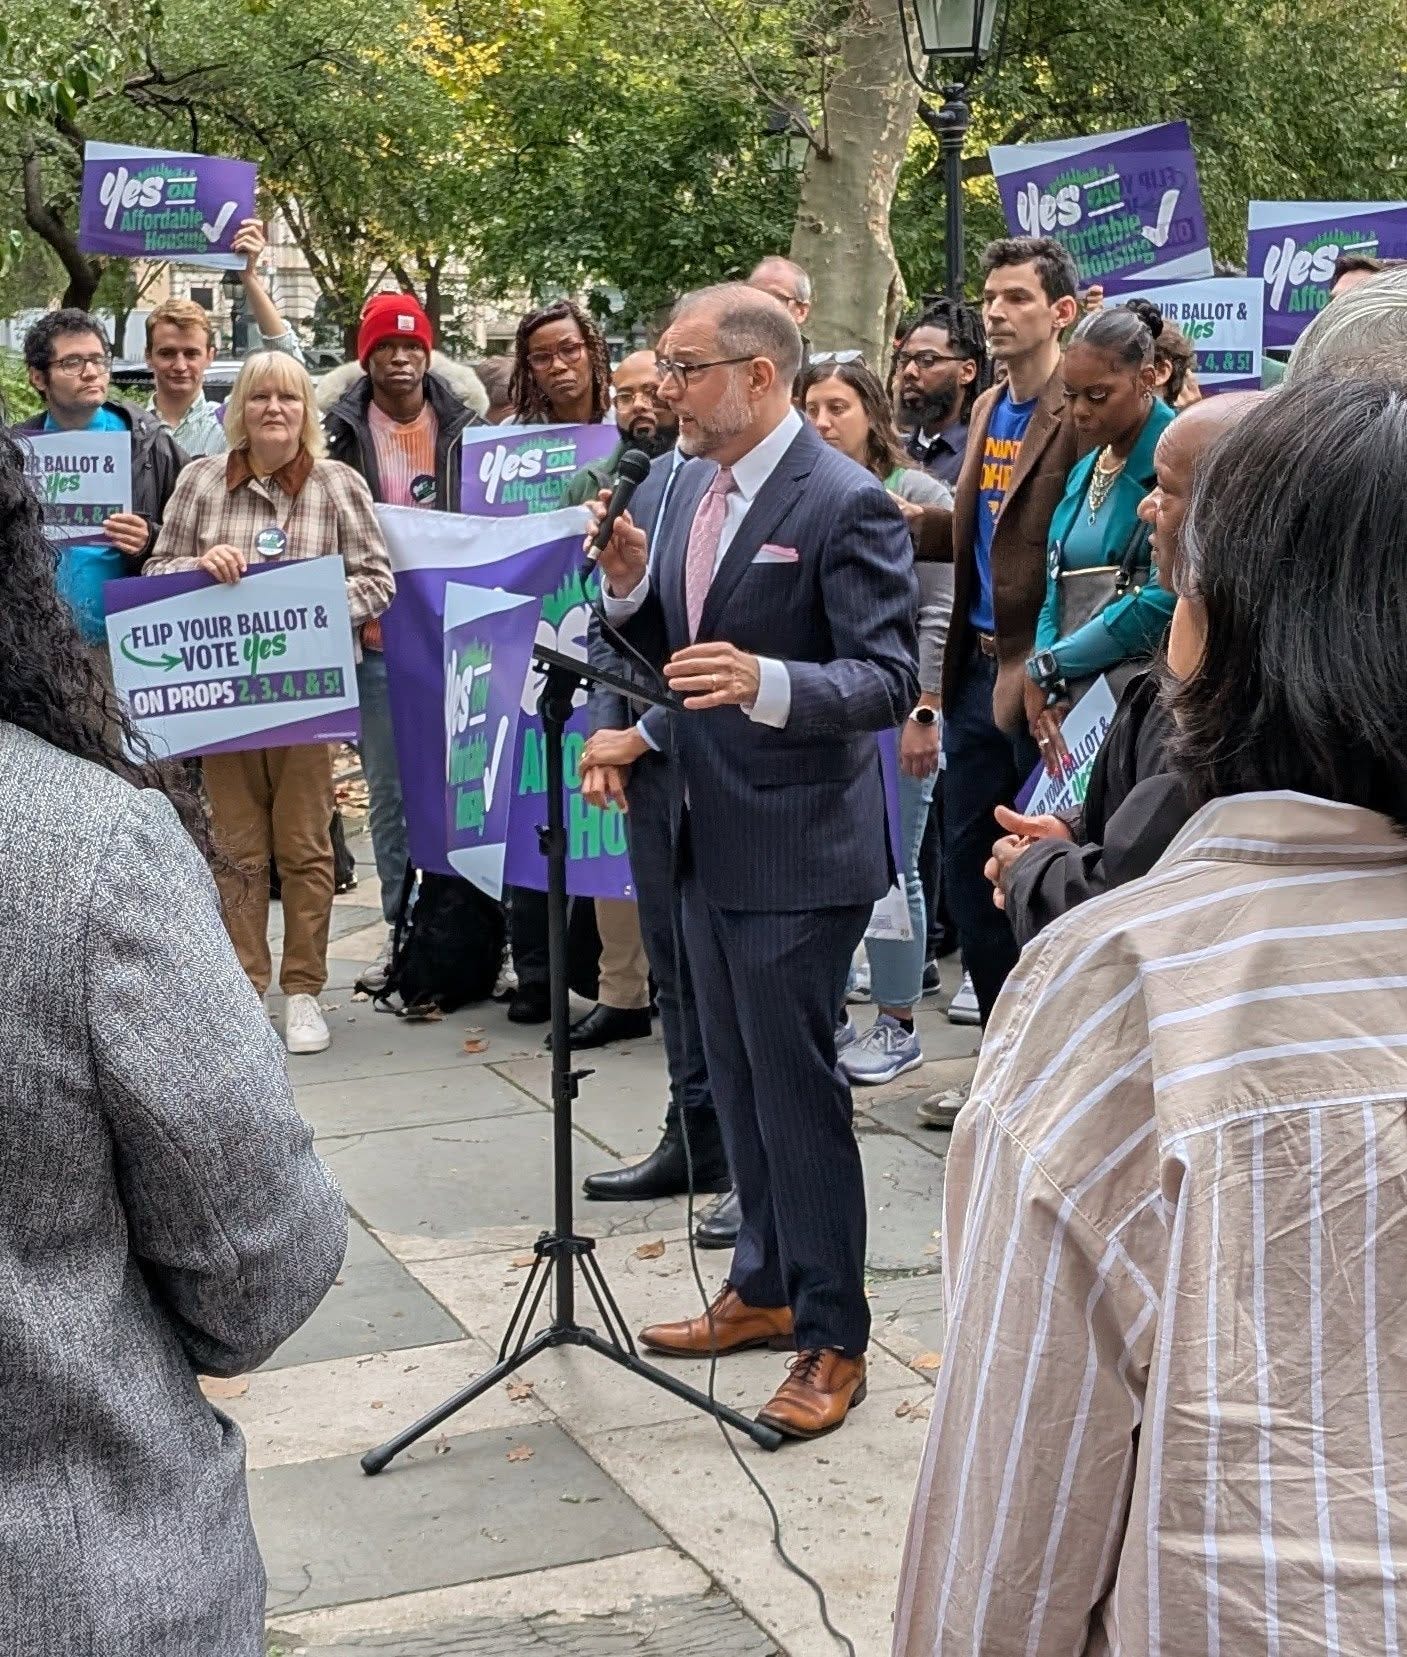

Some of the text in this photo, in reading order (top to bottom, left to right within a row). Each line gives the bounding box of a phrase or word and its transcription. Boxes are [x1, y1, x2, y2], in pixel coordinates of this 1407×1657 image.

[120, 206, 204, 233] Affordable
[1181, 303, 1233, 321] BALLOT
[1236, 302, 1248, 321] &
[44, 455, 100, 473] BALLOT
[102, 455, 115, 474] &
[131, 604, 329, 650] FLIP YOUR BALLOT &
[180, 641, 240, 672] VOTE
[133, 668, 341, 716] ON PROPS 2, 3, 4, & 5!
